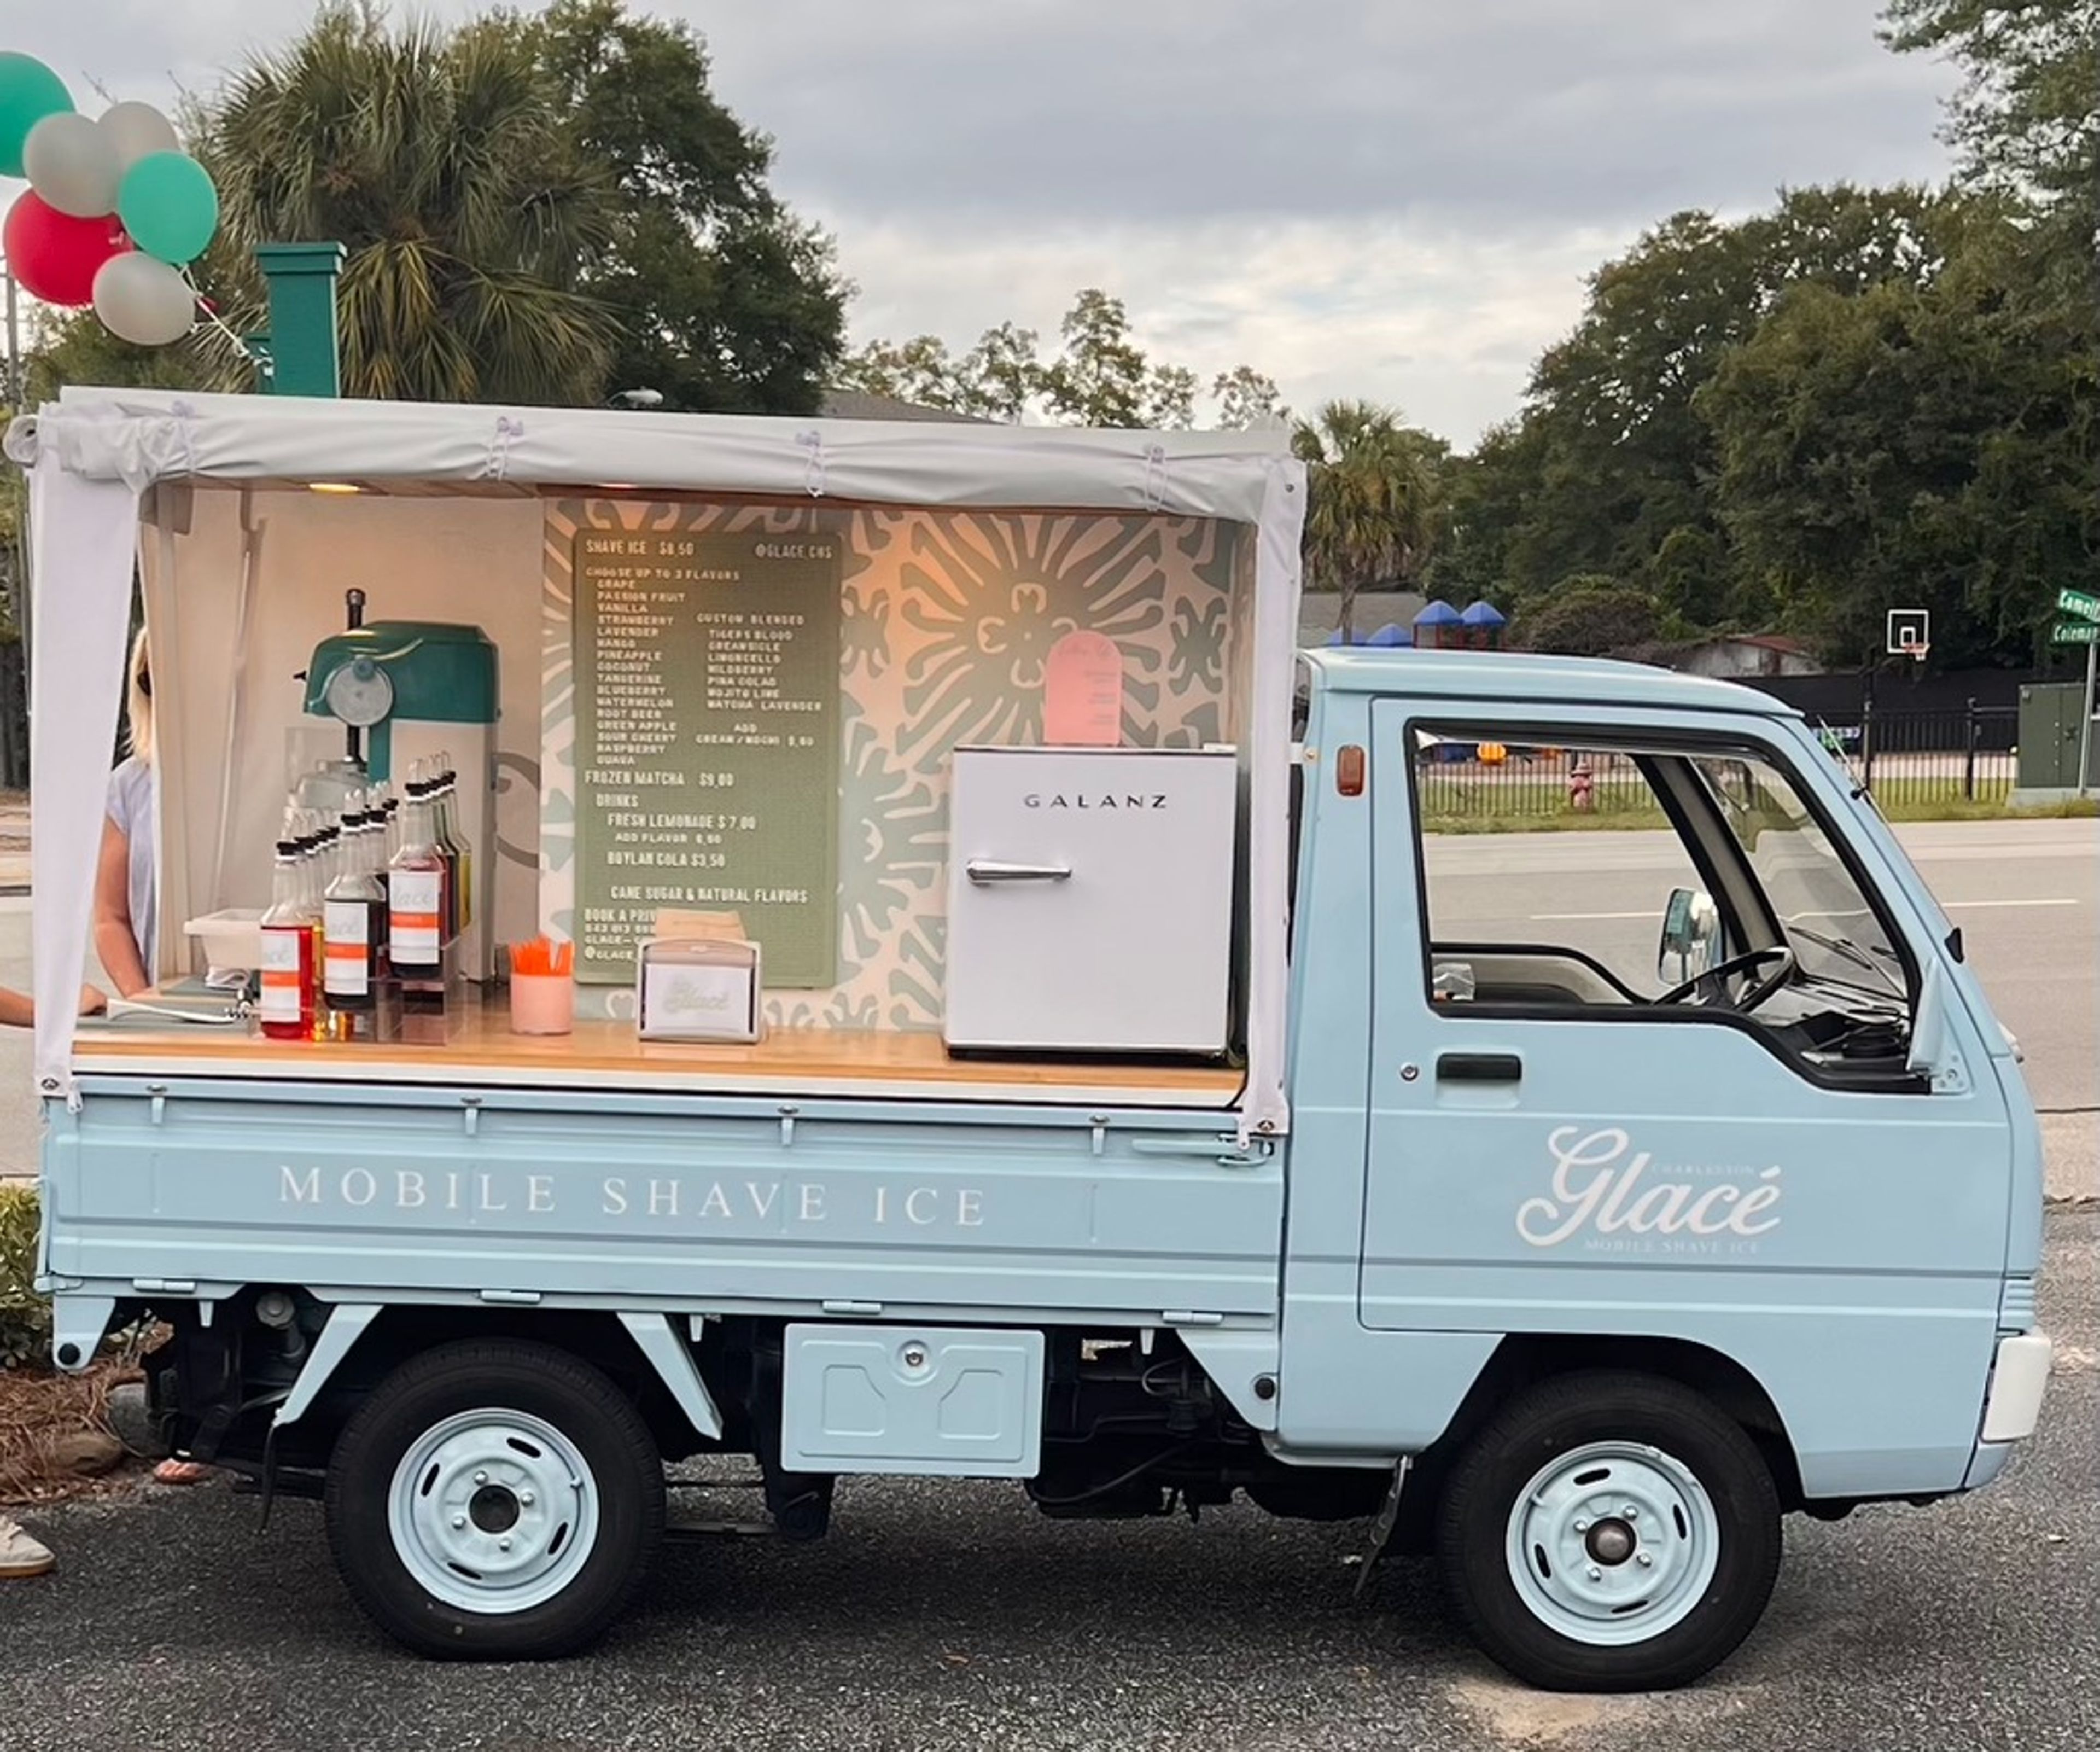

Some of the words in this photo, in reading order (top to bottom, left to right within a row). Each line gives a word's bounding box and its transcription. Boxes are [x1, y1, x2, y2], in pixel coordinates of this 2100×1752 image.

[586, 540, 625, 554] SHAVE
[628, 540, 646, 555] ICE
[586, 567, 632, 578] CHOOSE
[635, 568, 651, 577] UP
[656, 569, 671, 578] TO
[686, 570, 739, 580] FLAVORS
[597, 579, 635, 589] GRAPE
[597, 592, 648, 601] PASSION
[651, 592, 686, 602] FRUIT
[597, 604, 649, 613] VANILLA
[598, 615, 674, 625] STRAWBERRY
[697, 613, 743, 623] CUSTOM
[750, 615, 804, 625] BLENDED
[597, 627, 659, 637] LAVENDER
[754, 630, 793, 641] BLOOD
[597, 639, 636, 648] MANGO
[708, 641, 780, 651] CREAMSICLE
[597, 650, 662, 661] PINEAPPLE
[707, 653, 781, 663] LIMONCELLO
[597, 662, 651, 672] COCONUT
[707, 665, 773, 675] WILDBERRY
[597, 673, 662, 684] TANGERINE
[597, 685, 666, 695] BLUEBERRY
[707, 688, 750, 697] MOJITO
[752, 689, 780, 699] LIME
[597, 697, 674, 708] WATERMELON
[707, 700, 754, 709] MATCHA
[761, 701, 822, 711] LAVENDER
[597, 708, 627, 718] ROOT
[632, 709, 662, 719] BEER
[597, 720, 635, 730] GREEN
[639, 722, 677, 731] APPLE
[734, 723, 758, 733] ADD
[597, 732, 628, 742] SOUR
[631, 732, 677, 742] CHERRY
[597, 744, 666, 754] RASPBERRY
[597, 754, 636, 765] GUAVA
[585, 770, 631, 784] FROZEN
[633, 771, 685, 785] MATCHA
[596, 793, 639, 807] DRINKS
[1024, 794, 1166, 808] GALANZ
[608, 813, 646, 827] FRESH
[649, 814, 714, 829] LEMONADE
[615, 833, 638, 842] ADD
[641, 833, 689, 843] FLAVOR
[607, 851, 654, 865] BOYLAN
[656, 852, 687, 866] COLA
[610, 886, 641, 900] CANE
[645, 887, 683, 900] SUGAR
[697, 888, 751, 903] NATURAL
[754, 889, 808, 904] FLAVORS
[584, 909, 616, 922] BOOK
[619, 910, 627, 922] A
[1516, 1126, 1781, 1246] Glacé
[279, 1166, 555, 1212] MOBILE
[602, 1178, 827, 1220] SHAVE
[874, 1186, 985, 1226] ICE
[1586, 1239, 1654, 1253] MOBILE
[1661, 1241, 1718, 1253] SHAVE
[1730, 1243, 1759, 1254] ICE
